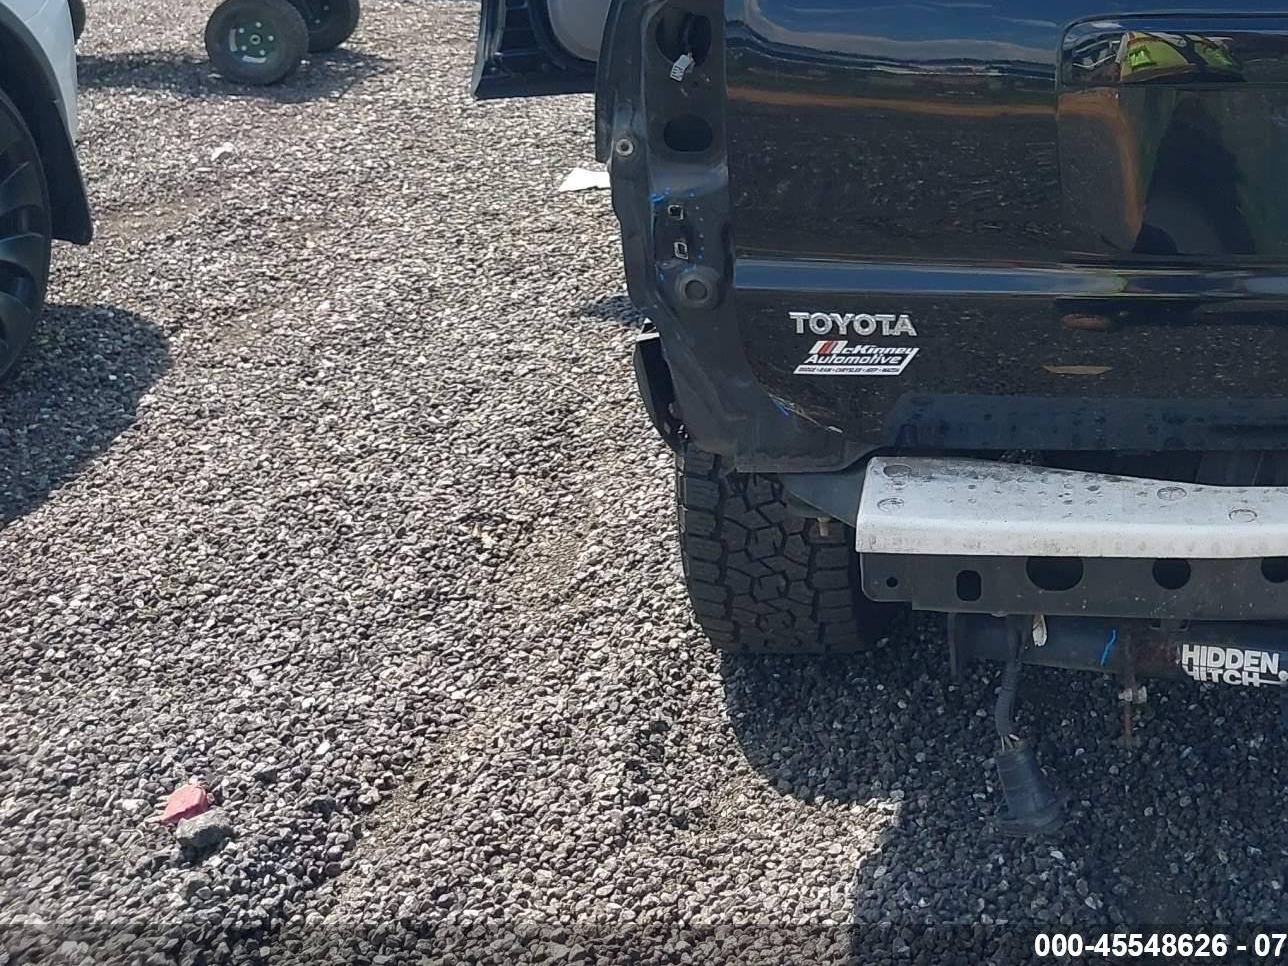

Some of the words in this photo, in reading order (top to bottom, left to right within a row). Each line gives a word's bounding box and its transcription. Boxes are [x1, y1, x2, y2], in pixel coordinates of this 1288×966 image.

[789, 312, 917, 336] TOYOTA
[803, 352, 902, 364] Automotive
[809, 340, 918, 354] McKinney
[1182, 644, 1279, 674] HIDDEN
[1182, 664, 1260, 687] HITCH
